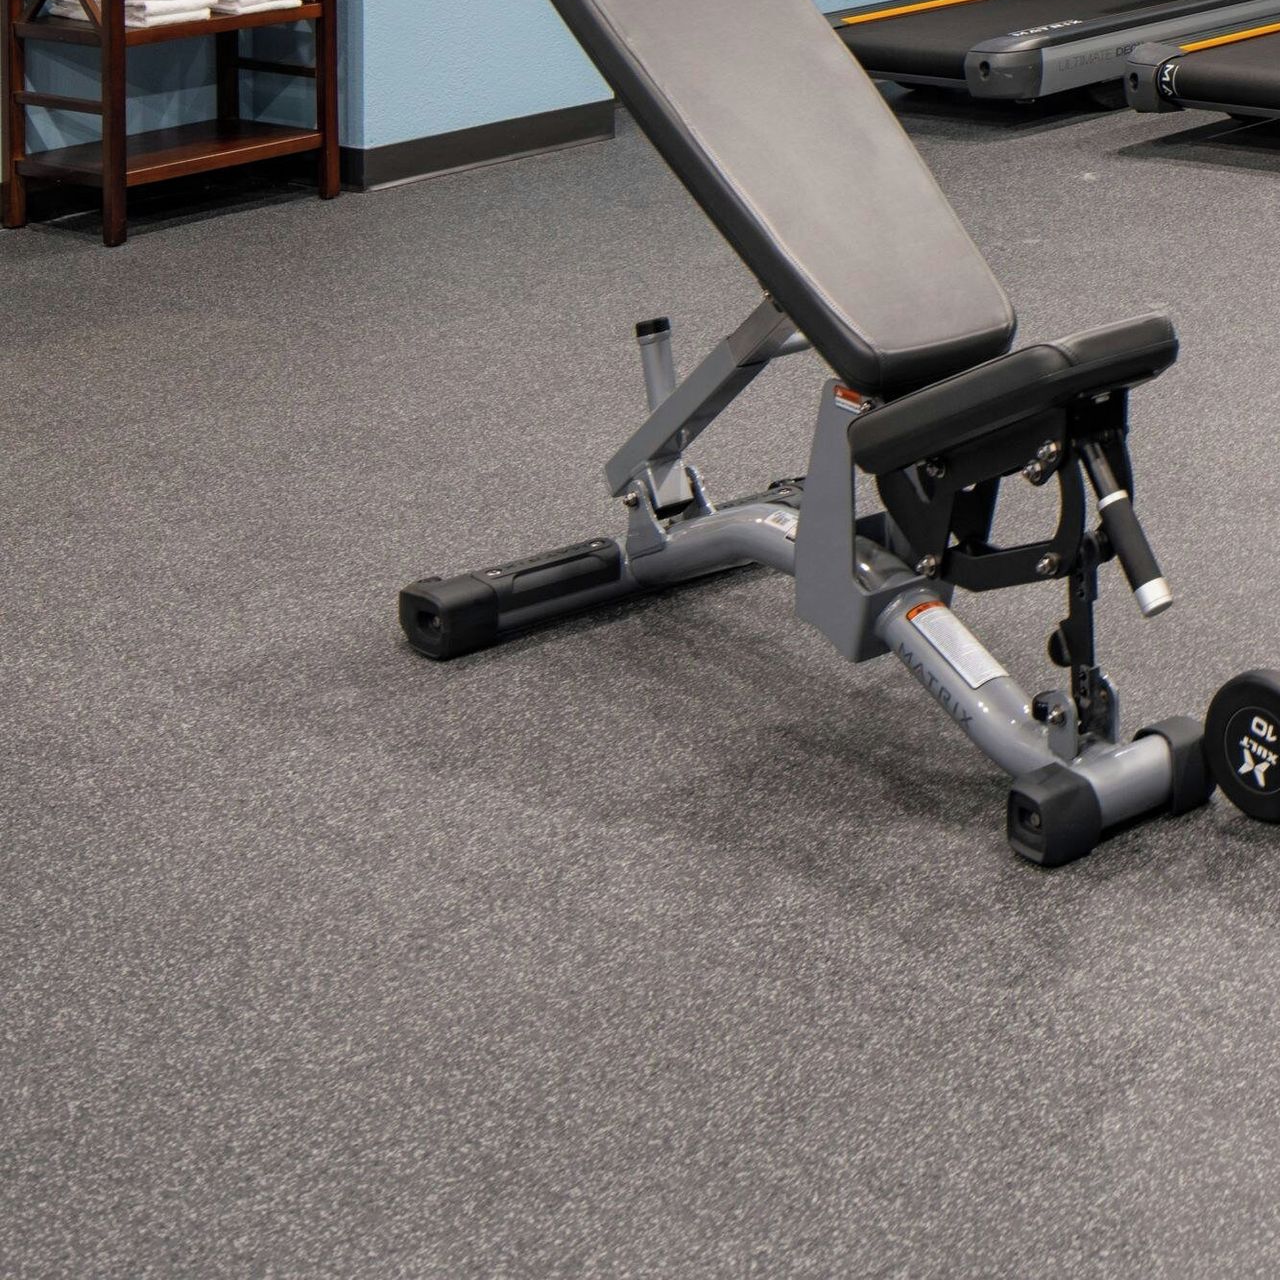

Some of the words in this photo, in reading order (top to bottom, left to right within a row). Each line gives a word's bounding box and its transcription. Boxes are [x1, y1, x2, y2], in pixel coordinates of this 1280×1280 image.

[899, 642, 973, 729] MATRIX
[1251, 716, 1277, 742] 10
[1239, 735, 1279, 766] XULT
